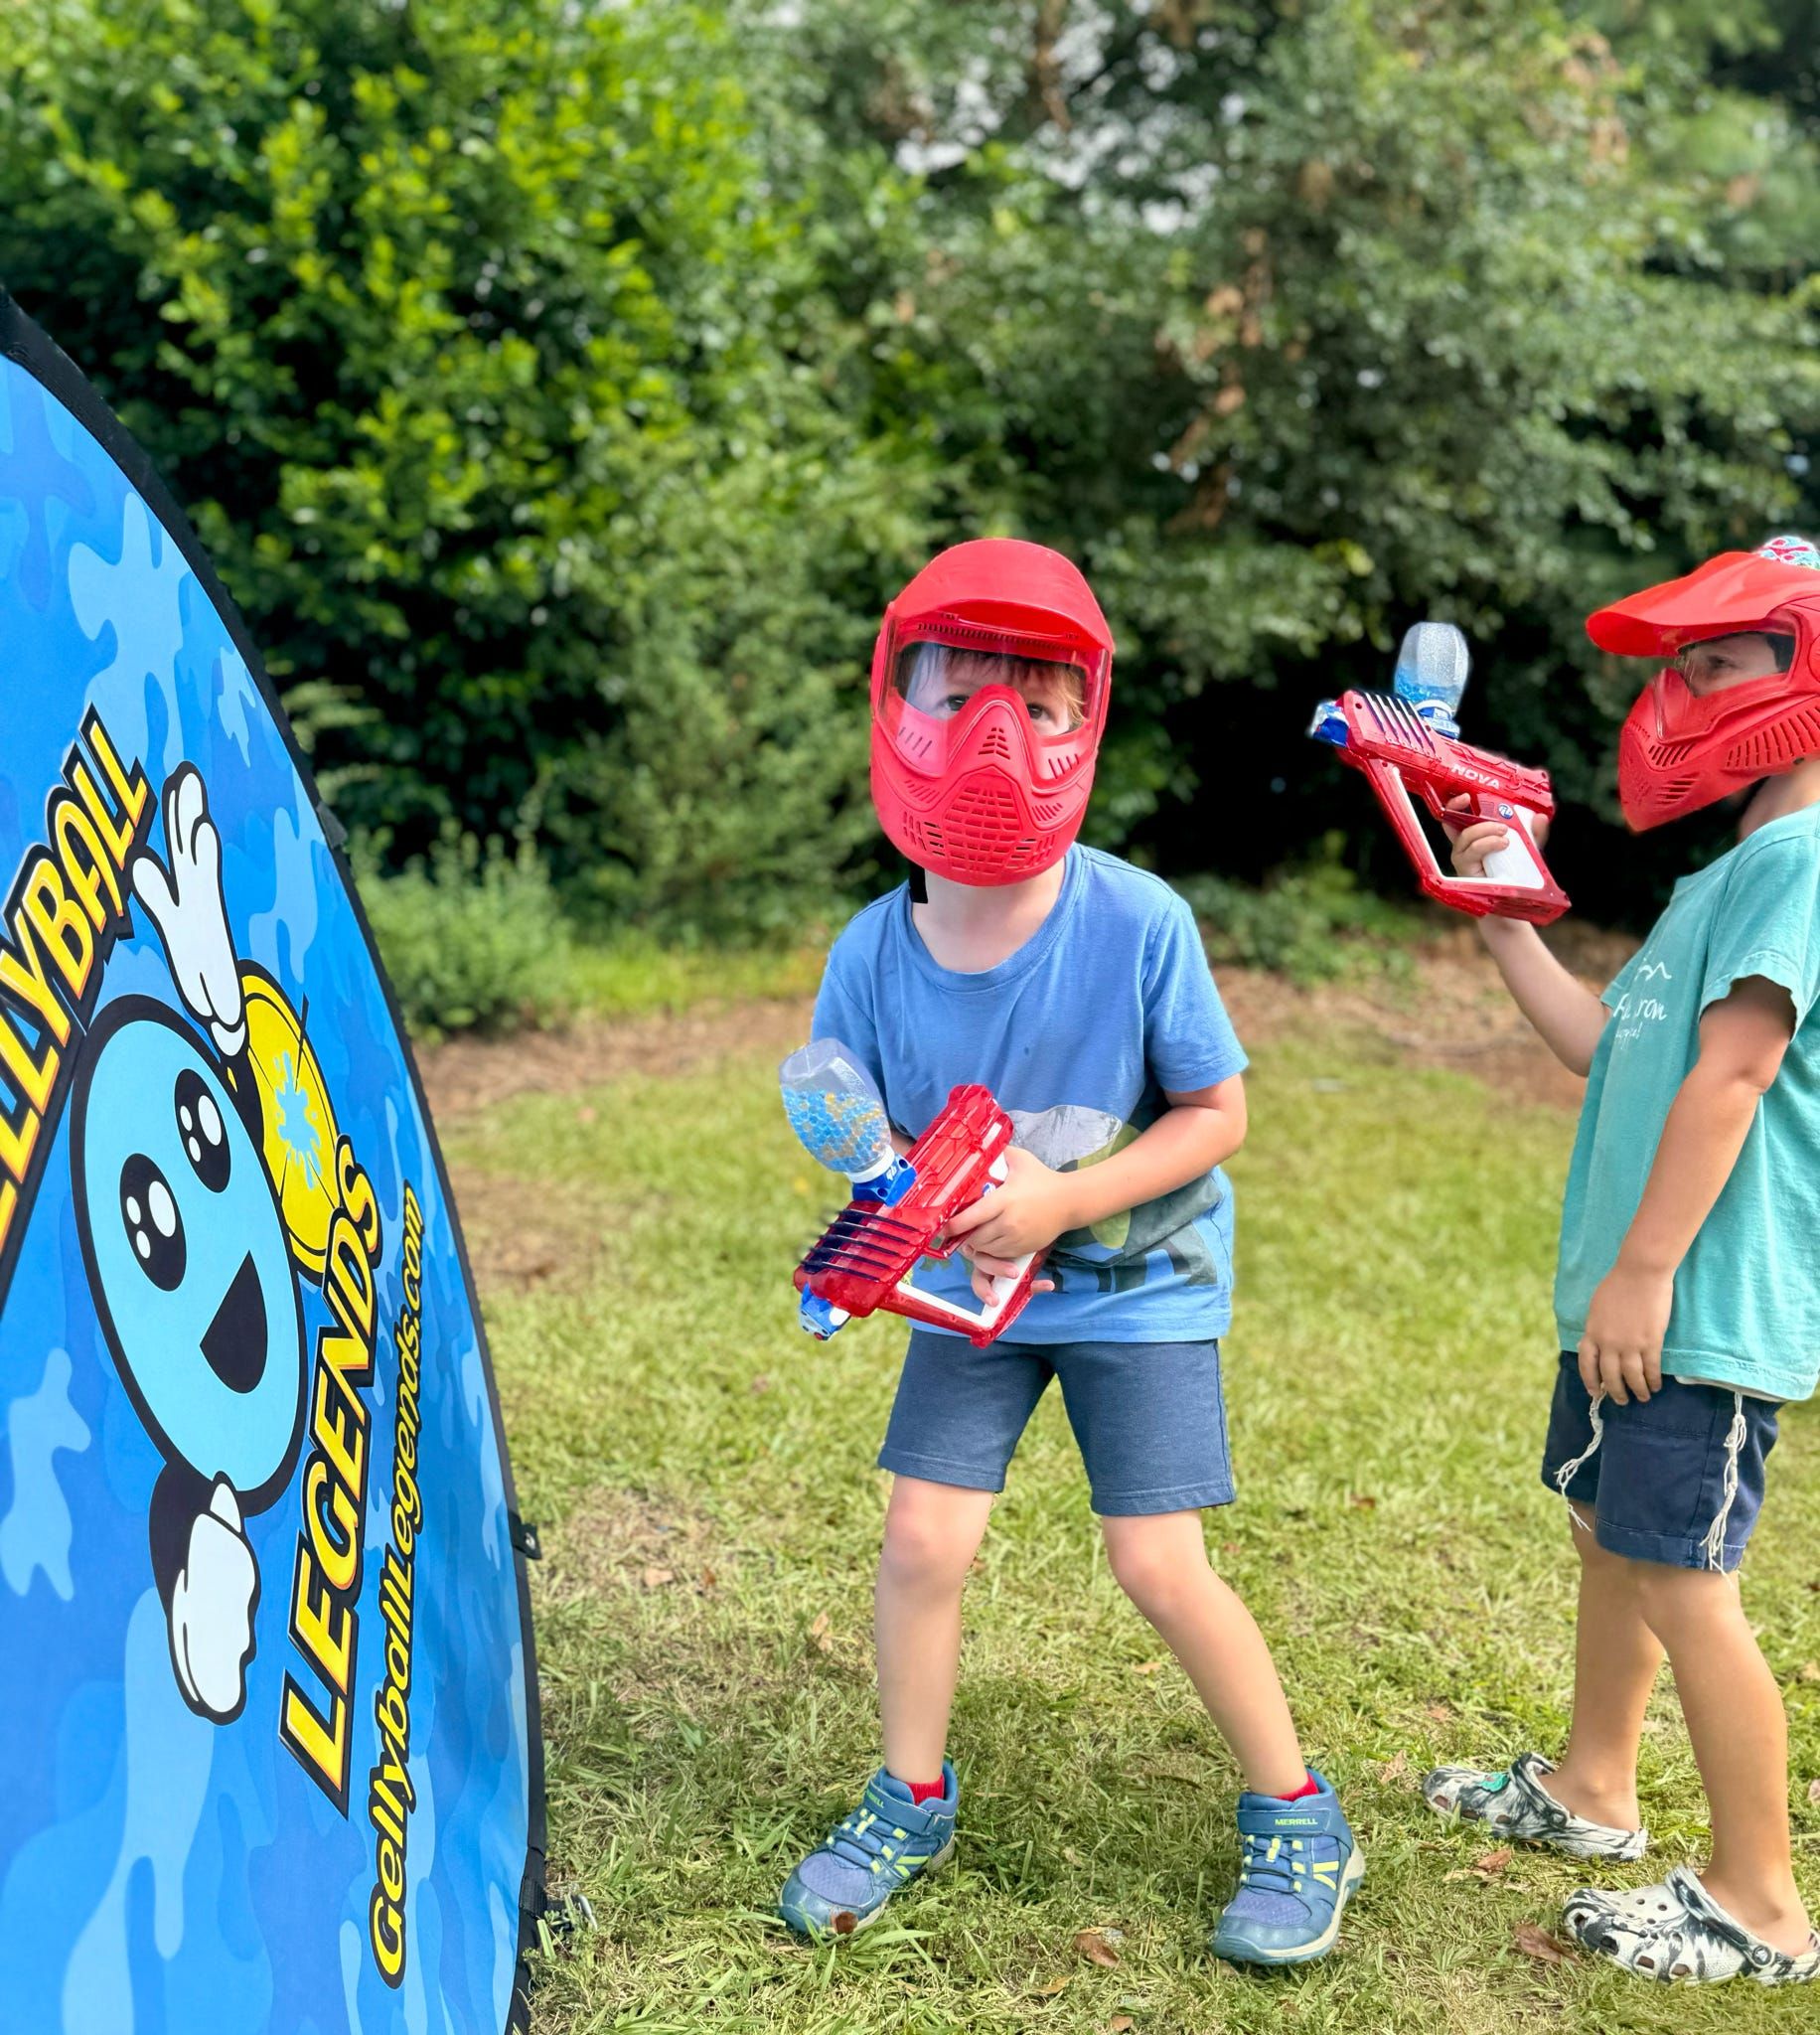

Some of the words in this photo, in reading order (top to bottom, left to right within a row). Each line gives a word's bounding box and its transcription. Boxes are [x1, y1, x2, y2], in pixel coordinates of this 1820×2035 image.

[0, 715, 149, 1252] LLYBALL
[1450, 763, 1500, 790] NOVA
[283, 1138, 380, 1799] LEGENDS
[372, 1183, 424, 1977] GellyballLegends.com
[1275, 1817, 1319, 1826] MERRELL
